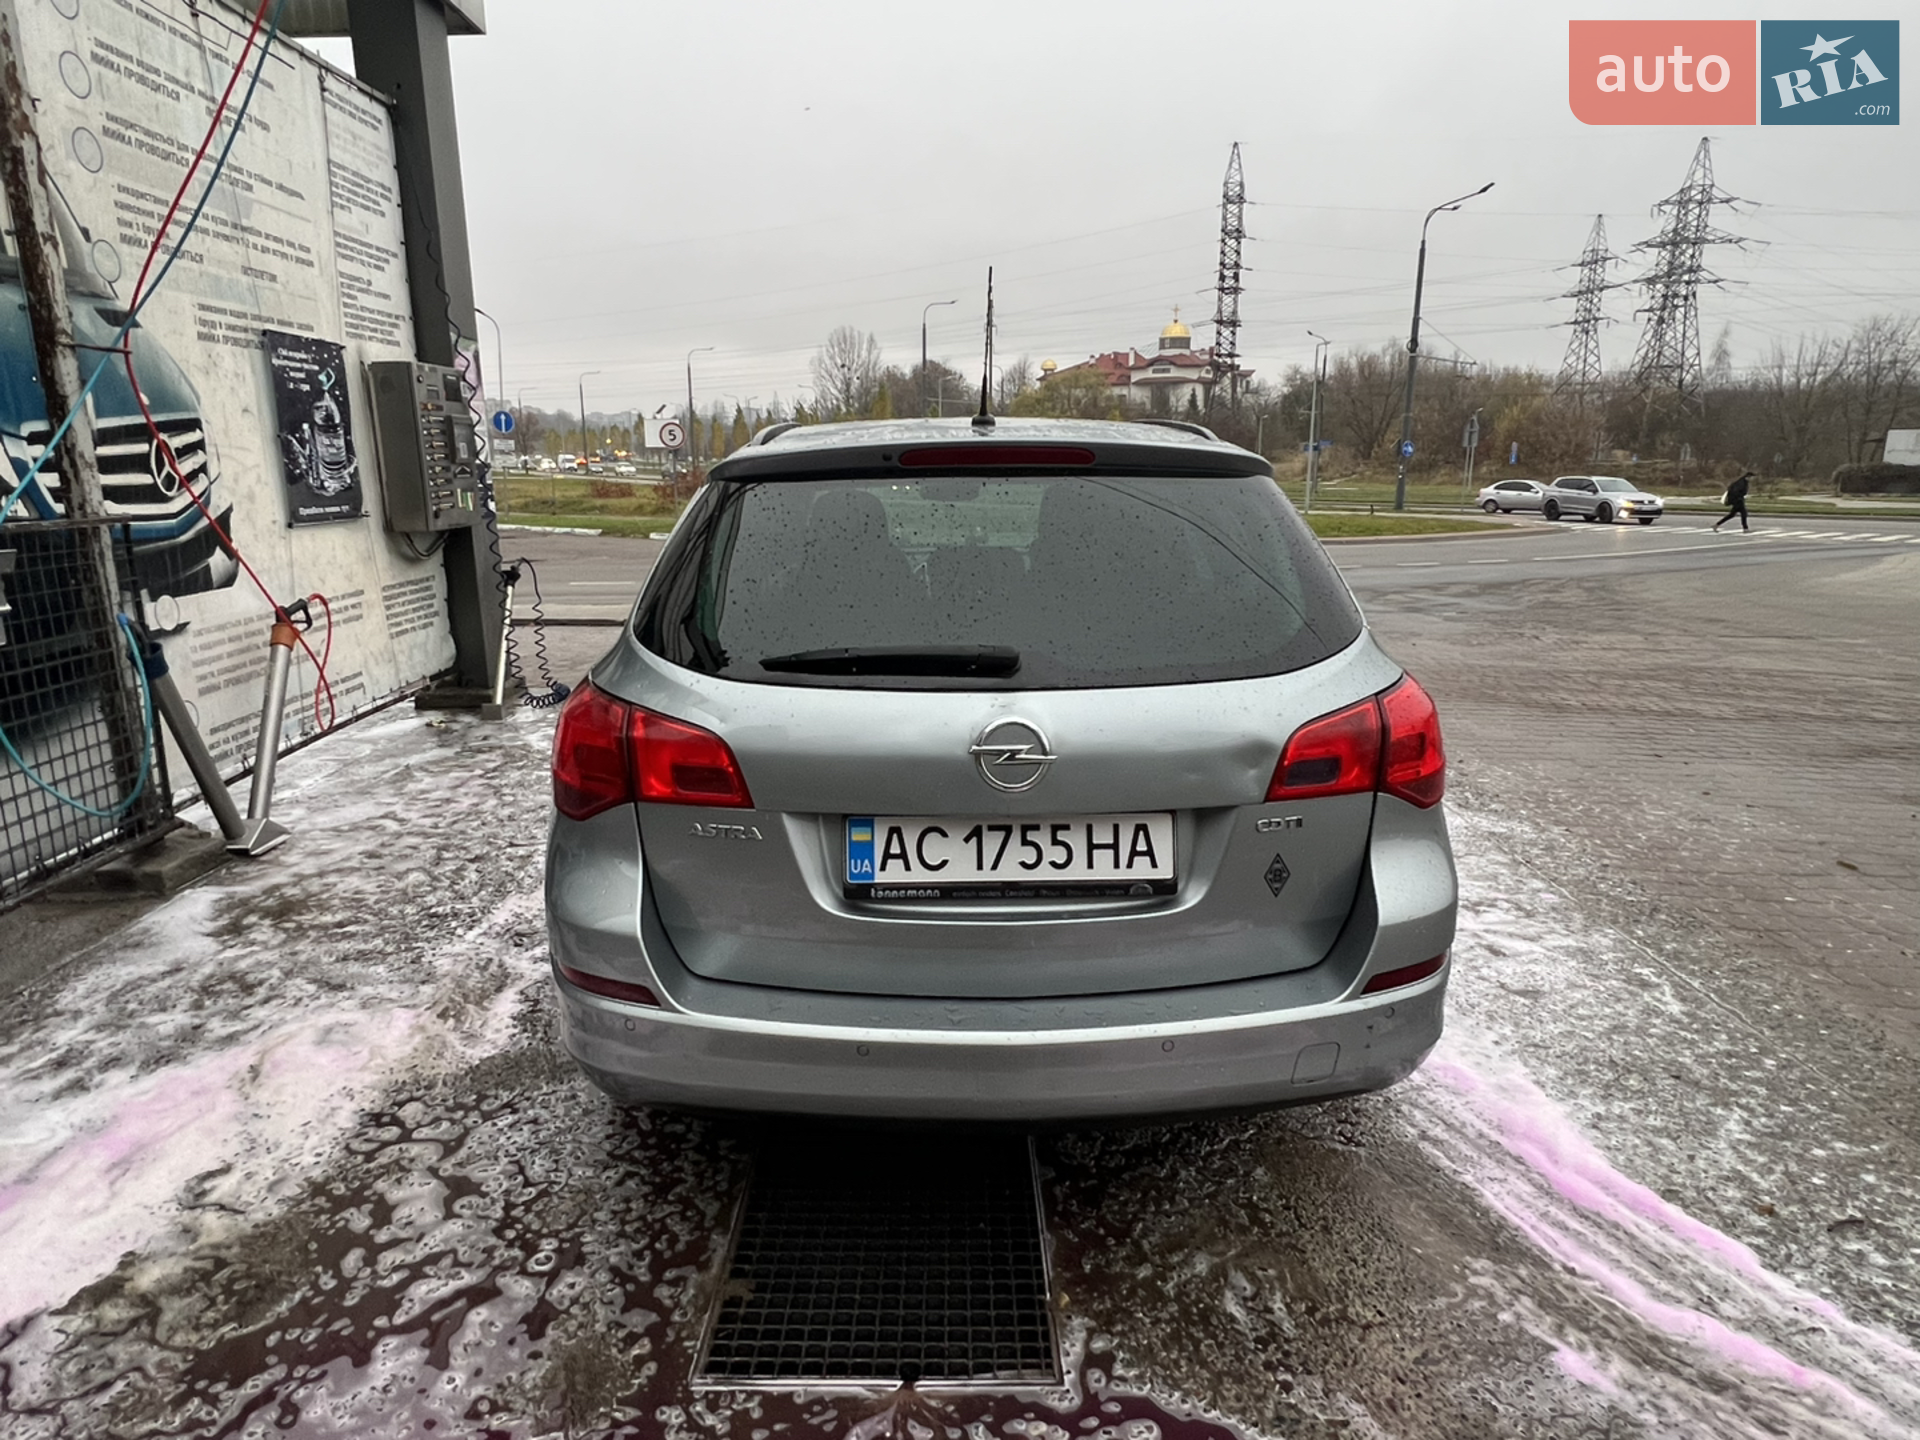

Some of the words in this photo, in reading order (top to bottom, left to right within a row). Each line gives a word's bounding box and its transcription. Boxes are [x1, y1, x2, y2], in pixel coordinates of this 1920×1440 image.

[124, 67, 181, 103] ПРОВОДИТЬСЯ
[101, 125, 133, 148] МИЙКА
[134, 137, 190, 168] ПРОВОДИТЬСЯ
[119, 232, 148, 250] МИЙКА
[668, 429, 677, 442] 5
[688, 822, 763, 840] ASTRA
[879, 825, 950, 872] AC
[962, 823, 1074, 872] 1755
[1086, 823, 1159, 870] HA
[851, 859, 873, 874] UA
